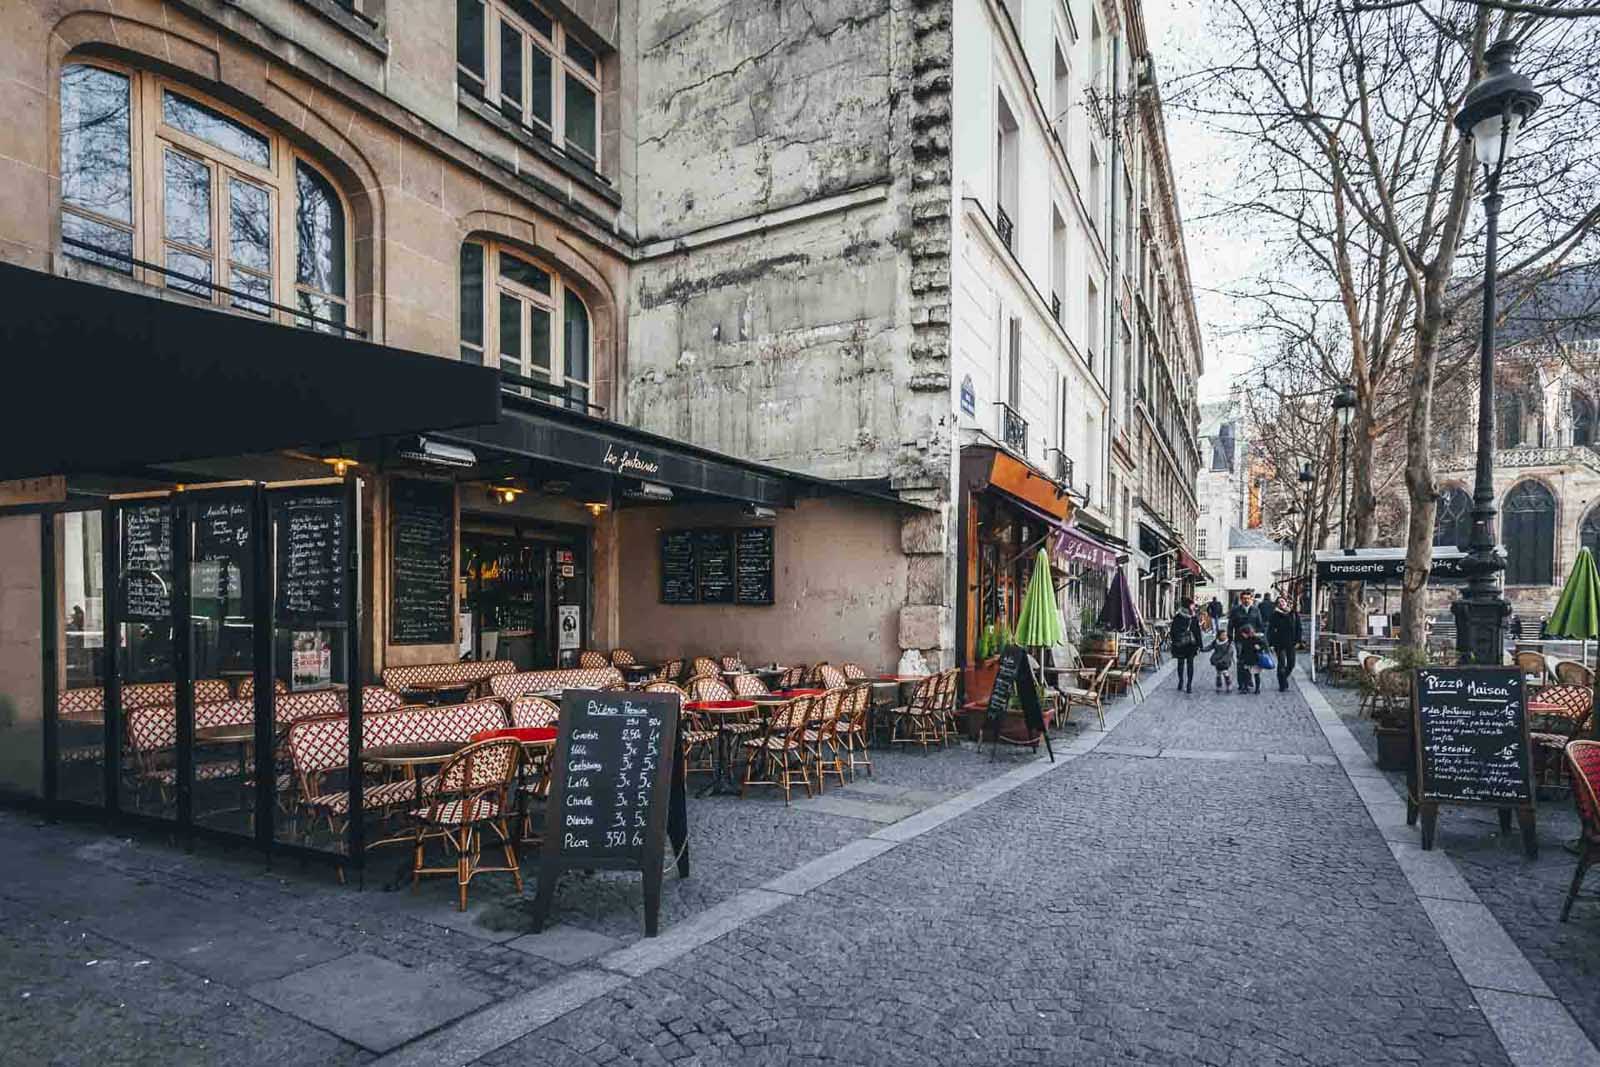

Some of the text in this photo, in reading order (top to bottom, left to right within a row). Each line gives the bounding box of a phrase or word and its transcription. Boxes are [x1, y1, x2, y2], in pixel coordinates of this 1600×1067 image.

[1330, 563, 1384, 573] brasserie
[568, 776, 590, 788] Leffe
[564, 832, 590, 849] Picon
